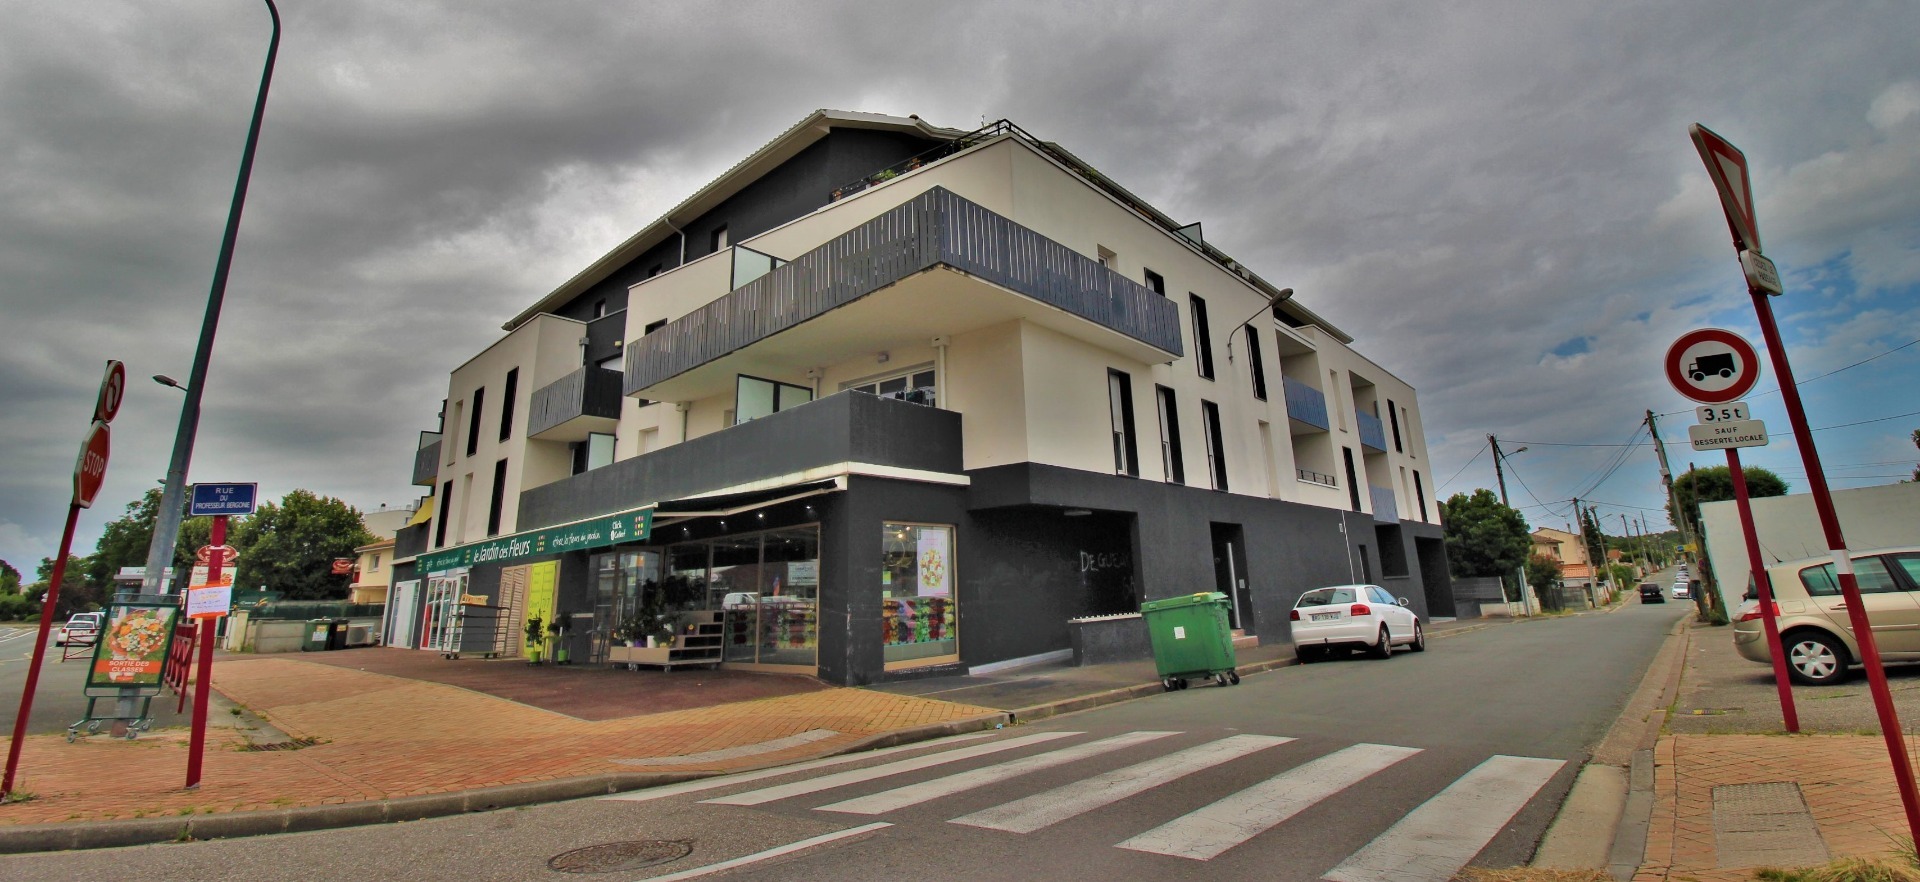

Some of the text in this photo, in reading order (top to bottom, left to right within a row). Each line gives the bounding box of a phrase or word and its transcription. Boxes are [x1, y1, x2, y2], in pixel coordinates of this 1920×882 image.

[1715, 426, 1737, 434] SAUF
[1694, 434, 1763, 446] DESSERTE LOCALE
[84, 450, 105, 478] STOP
[473, 549, 480, 562] le
[480, 542, 499, 562] Jardin
[499, 545, 508, 559] des
[508, 538, 530, 557] Fleurs
